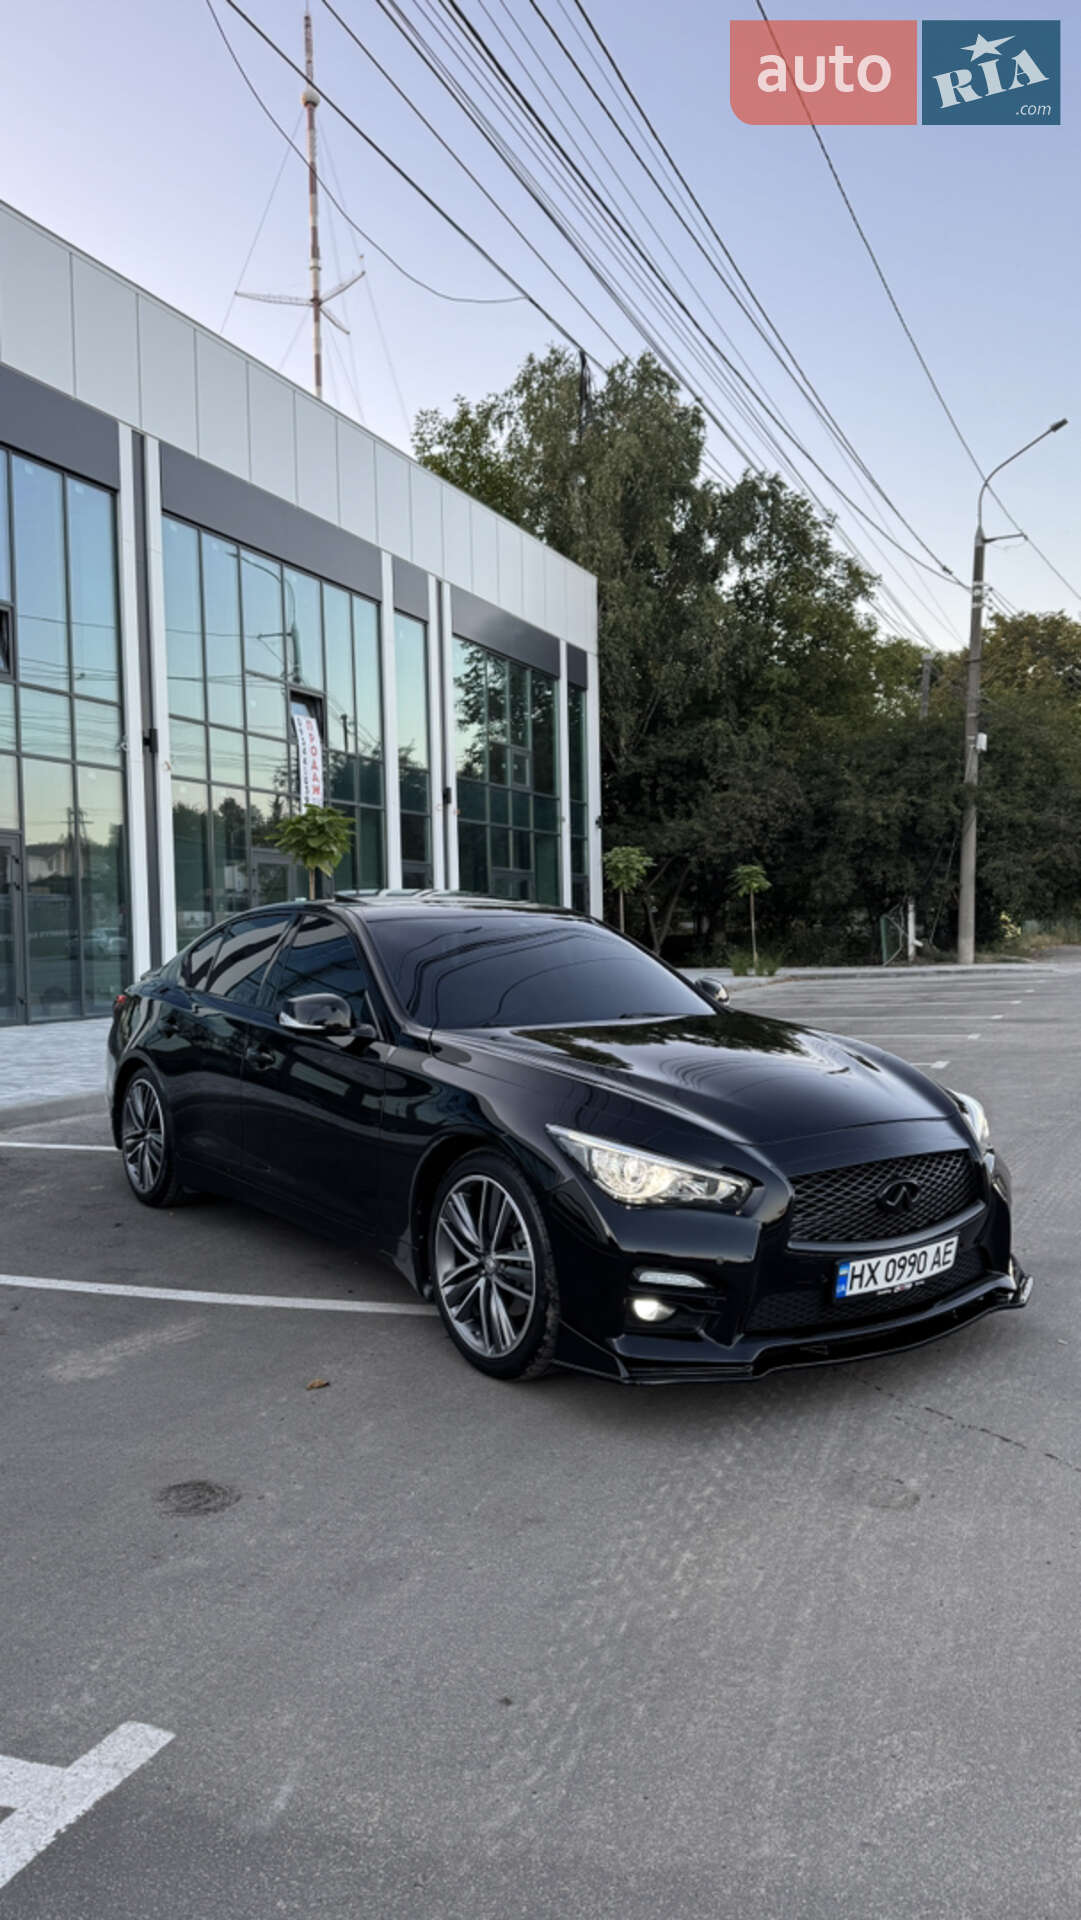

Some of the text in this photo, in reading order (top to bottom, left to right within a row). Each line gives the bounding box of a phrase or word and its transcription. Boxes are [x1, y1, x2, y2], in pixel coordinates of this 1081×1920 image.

[849, 1260, 881, 1291] HX
[884, 1250, 928, 1283] 0990
[930, 1241, 954, 1271] AE
